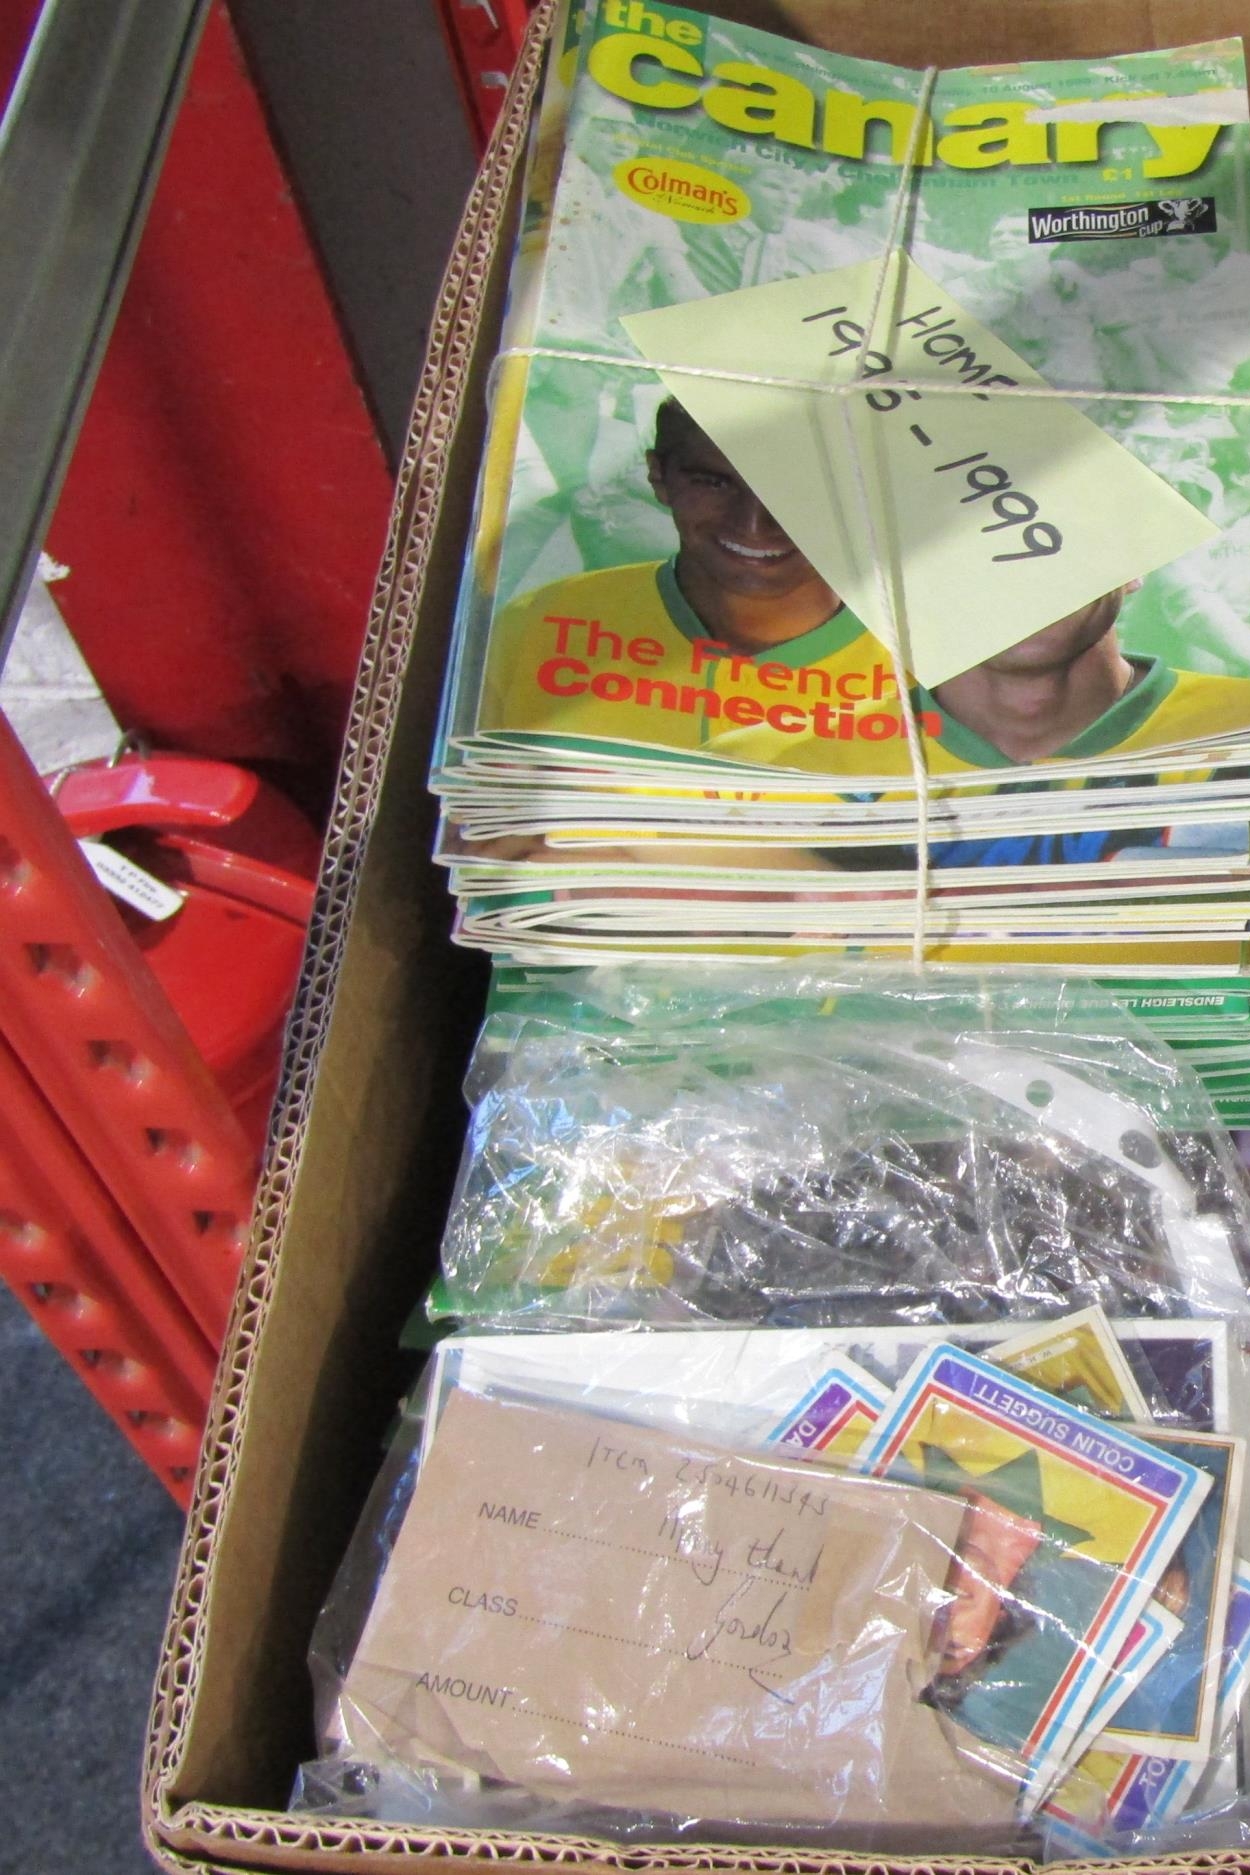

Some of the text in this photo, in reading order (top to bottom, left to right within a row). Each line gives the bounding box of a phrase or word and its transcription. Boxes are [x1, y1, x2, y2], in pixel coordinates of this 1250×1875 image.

[601, 0, 703, 46] the
[587, 32, 1223, 180] canary
[627, 166, 739, 216] Colman's
[1031, 204, 1150, 240] Worthington
[934, 451, 1063, 563] 1999
[543, 615, 904, 702] The French
[536, 657, 943, 741] Connection
[1141, 996, 1225, 1008] ENDSLEIGH
[973, 1383, 1135, 1473] COLIN SUGGETT
[479, 1502, 542, 1531] NAME
[447, 1586, 520, 1618] CLASS
[415, 1672, 513, 1709] AMOUNT
